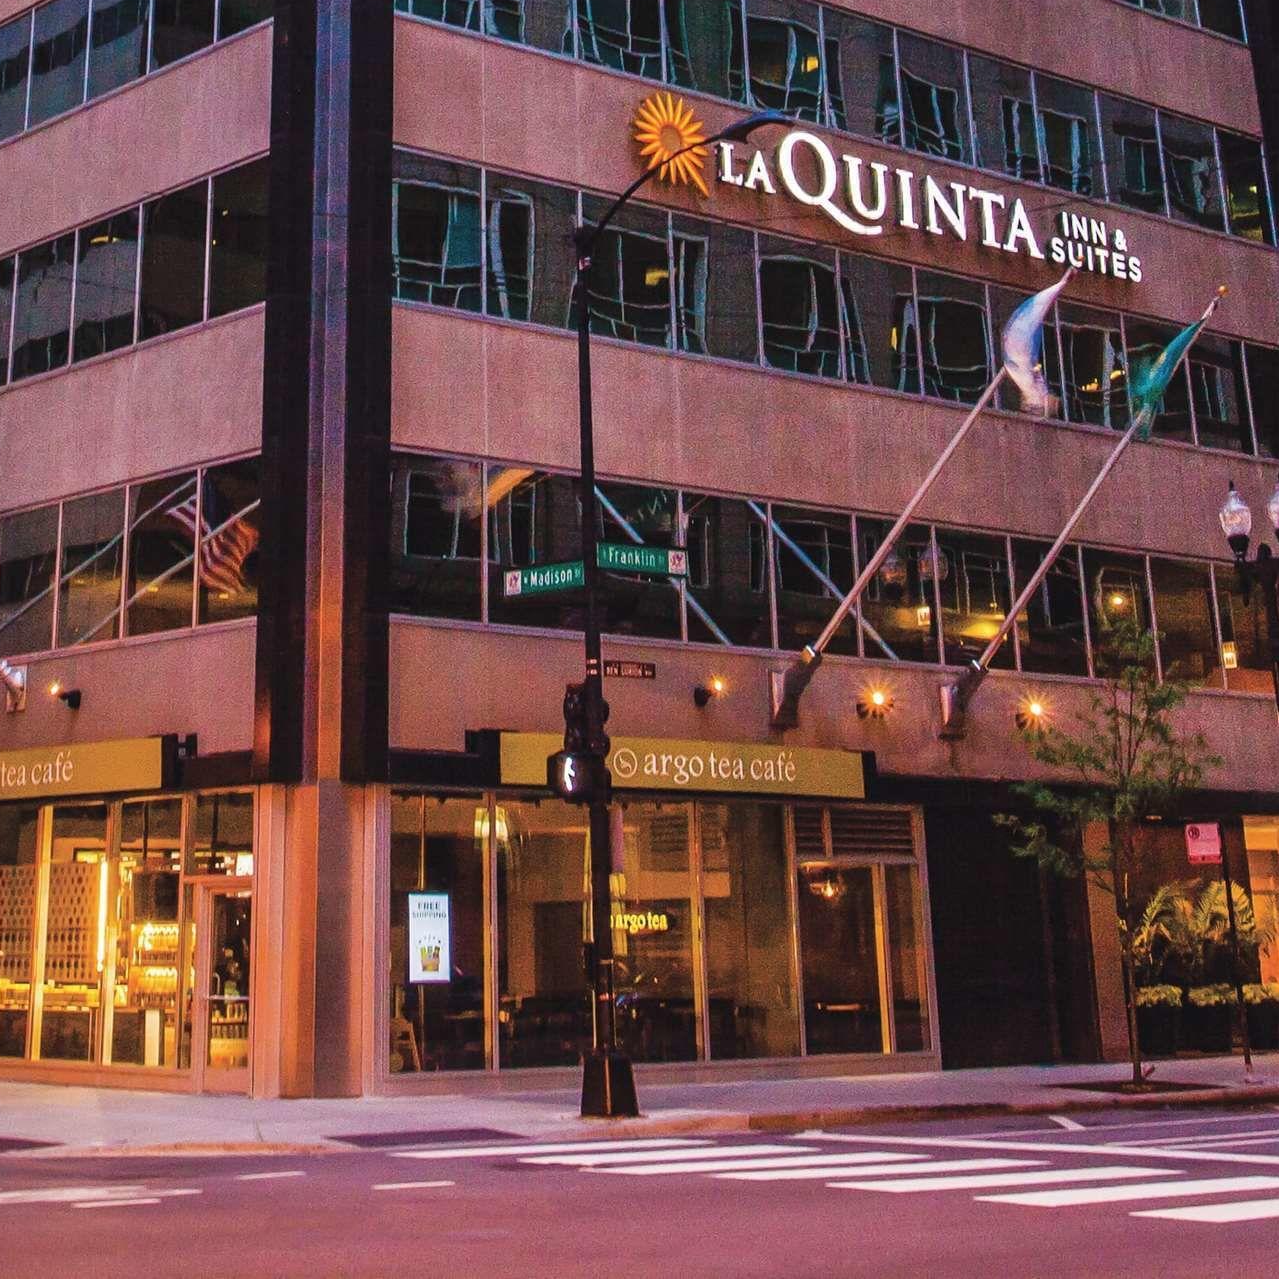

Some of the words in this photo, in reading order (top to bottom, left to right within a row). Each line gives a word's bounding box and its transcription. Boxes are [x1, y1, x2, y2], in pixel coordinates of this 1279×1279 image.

[720, 142, 776, 195] LA
[779, 130, 1045, 260] QUINTA
[1061, 211, 1107, 245] INN
[1114, 228, 1129, 253] &
[1051, 237, 1142, 283] SUITES
[608, 547, 656, 568] Franklin
[530, 568, 573, 588] Madison
[1, 760, 26, 788] tea
[31, 750, 73, 785] café
[644, 752, 704, 785] argo
[709, 751, 745, 780] tea
[750, 751, 797, 782] café
